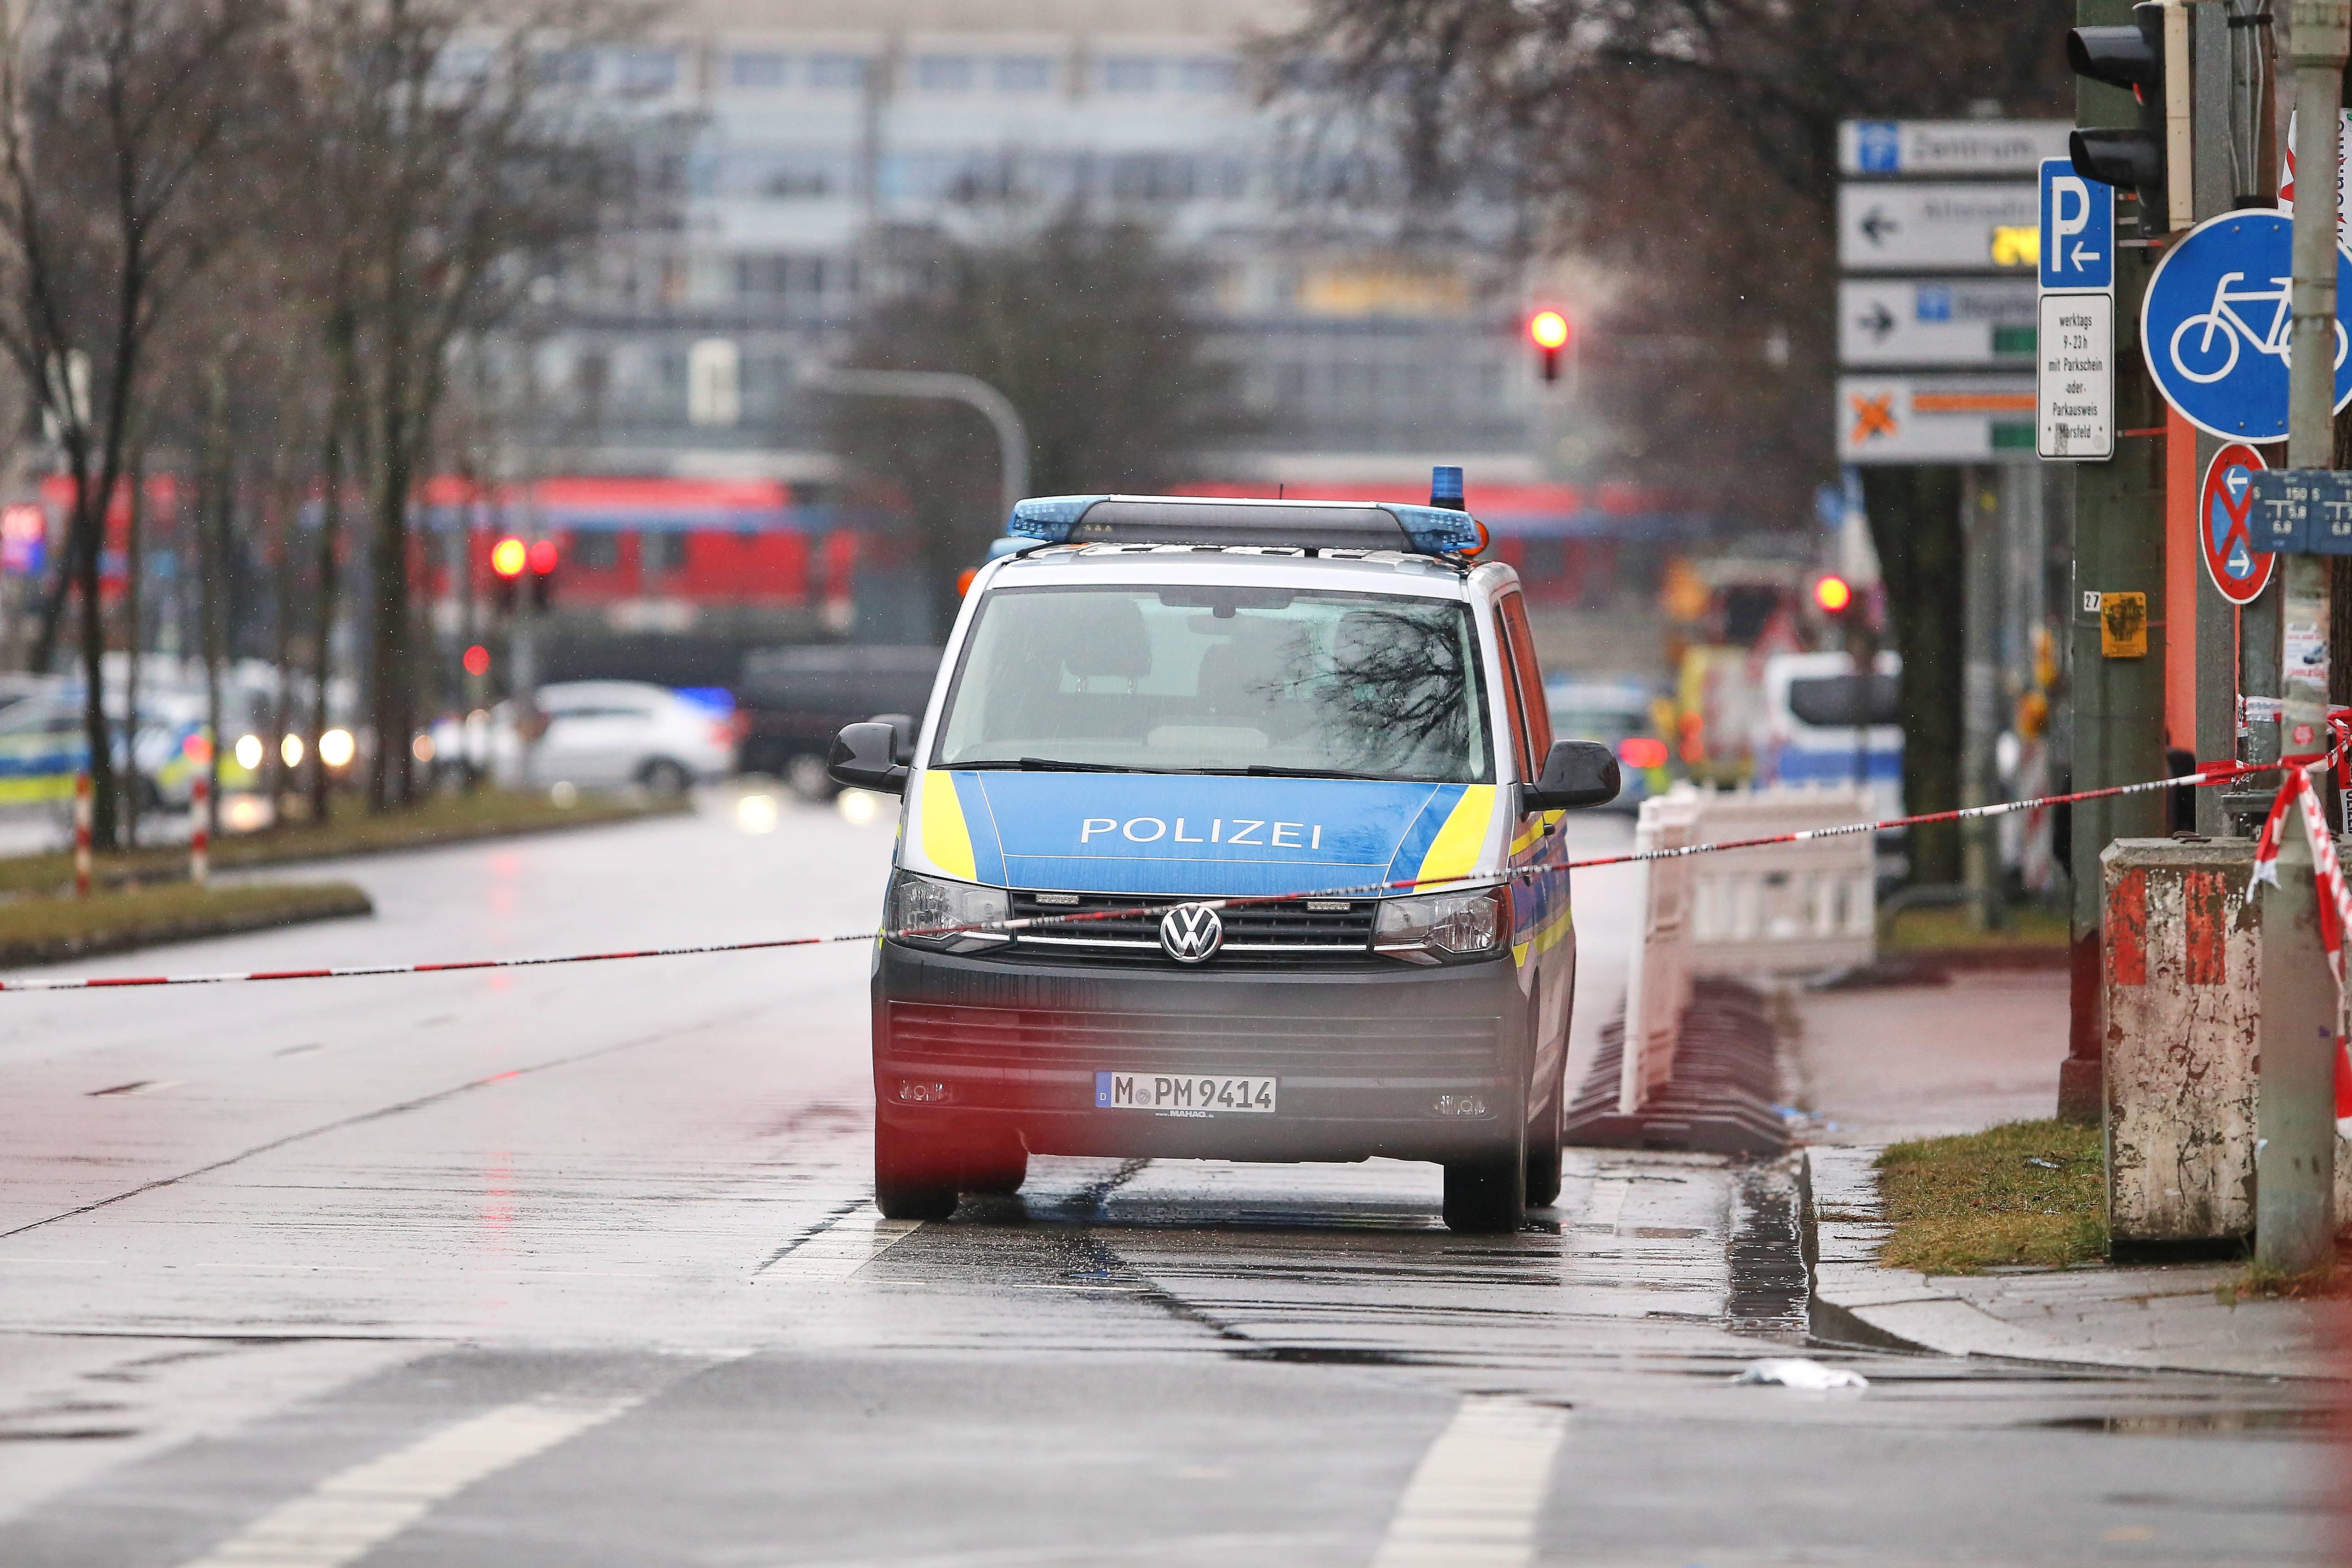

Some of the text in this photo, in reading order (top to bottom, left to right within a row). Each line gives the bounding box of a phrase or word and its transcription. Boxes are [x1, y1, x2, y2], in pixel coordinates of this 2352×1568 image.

[2052, 176, 2090, 272] P
[2059, 313, 2092, 330] werktags
[2049, 357, 2102, 371] mit Parkschein
[2053, 402, 2097, 415] Parkausweis
[2086, 594, 2099, 609] 27
[1080, 817, 1322, 850] POLIZEI
[1115, 1077, 1272, 1109] M PM 9414
